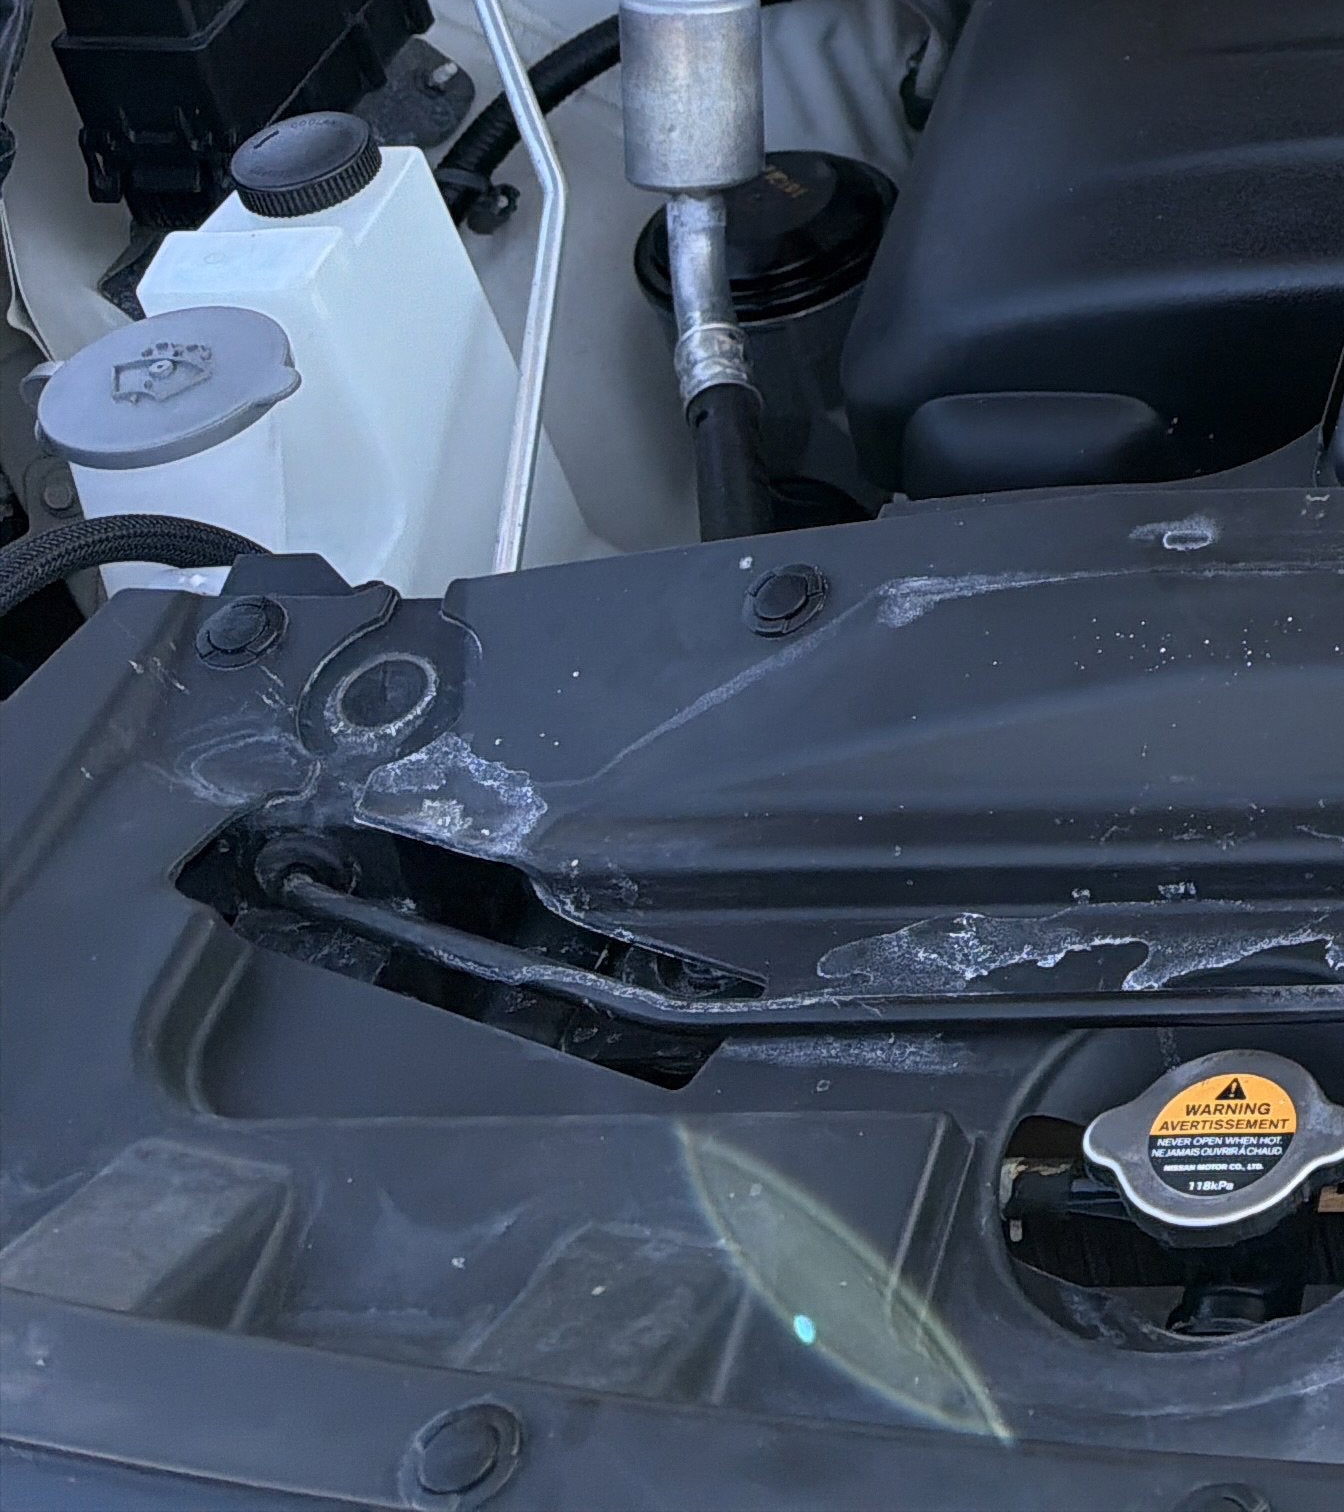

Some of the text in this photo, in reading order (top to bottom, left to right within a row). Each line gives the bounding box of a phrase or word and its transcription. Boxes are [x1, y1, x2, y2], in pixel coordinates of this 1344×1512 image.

[1184, 1102, 1272, 1117] WARNING
[1158, 1118, 1290, 1132] AVERTISSEMENT
[1156, 1137, 1192, 1147] NEVER
[1192, 1136, 1223, 1146] OPEN
[1224, 1136, 1258, 1145] WHEN
[1150, 1148, 1167, 1158] NE
[1165, 1148, 1200, 1157] JAMAIS
[1200, 1147, 1239, 1156] OUVRIR
[1196, 1163, 1229, 1171] MOTOR
[1188, 1181, 1235, 1191] 118kPa
